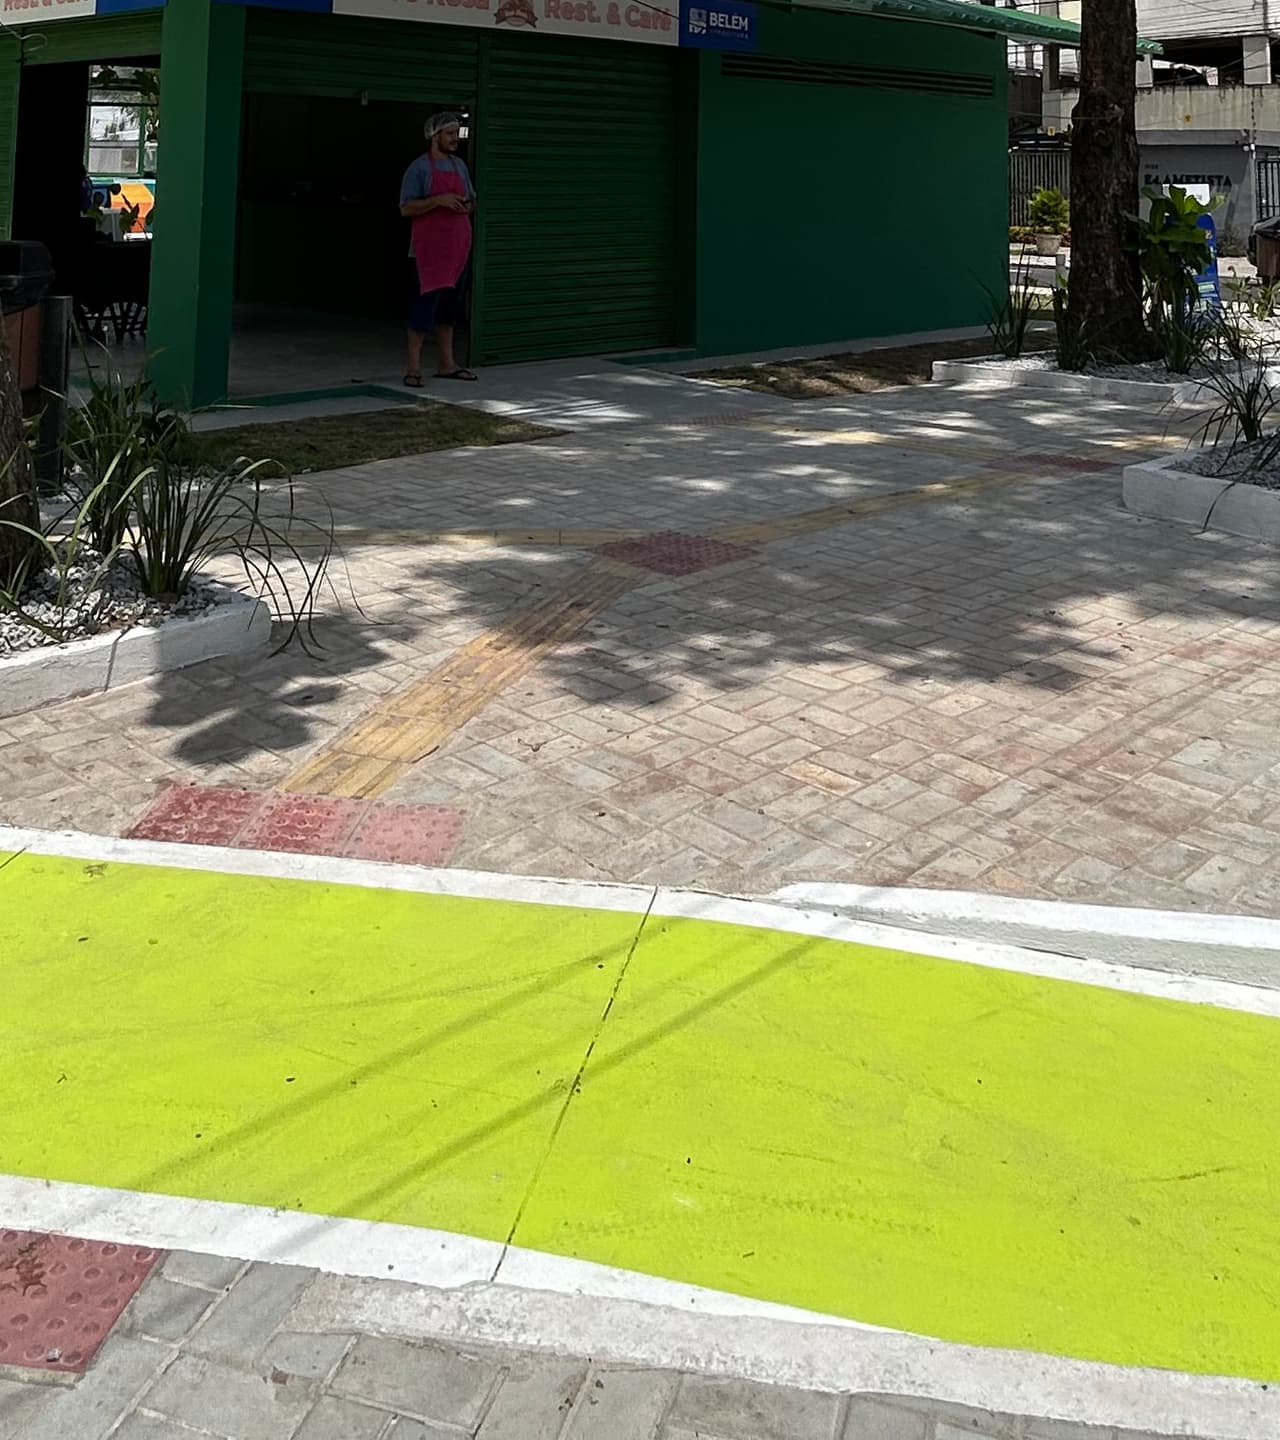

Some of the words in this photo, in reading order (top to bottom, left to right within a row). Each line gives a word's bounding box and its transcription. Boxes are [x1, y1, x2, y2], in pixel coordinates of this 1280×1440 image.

[606, 2, 620, 26] &
[624, 5, 672, 32] Café
[1162, 174, 1232, 186] AMETISTA
